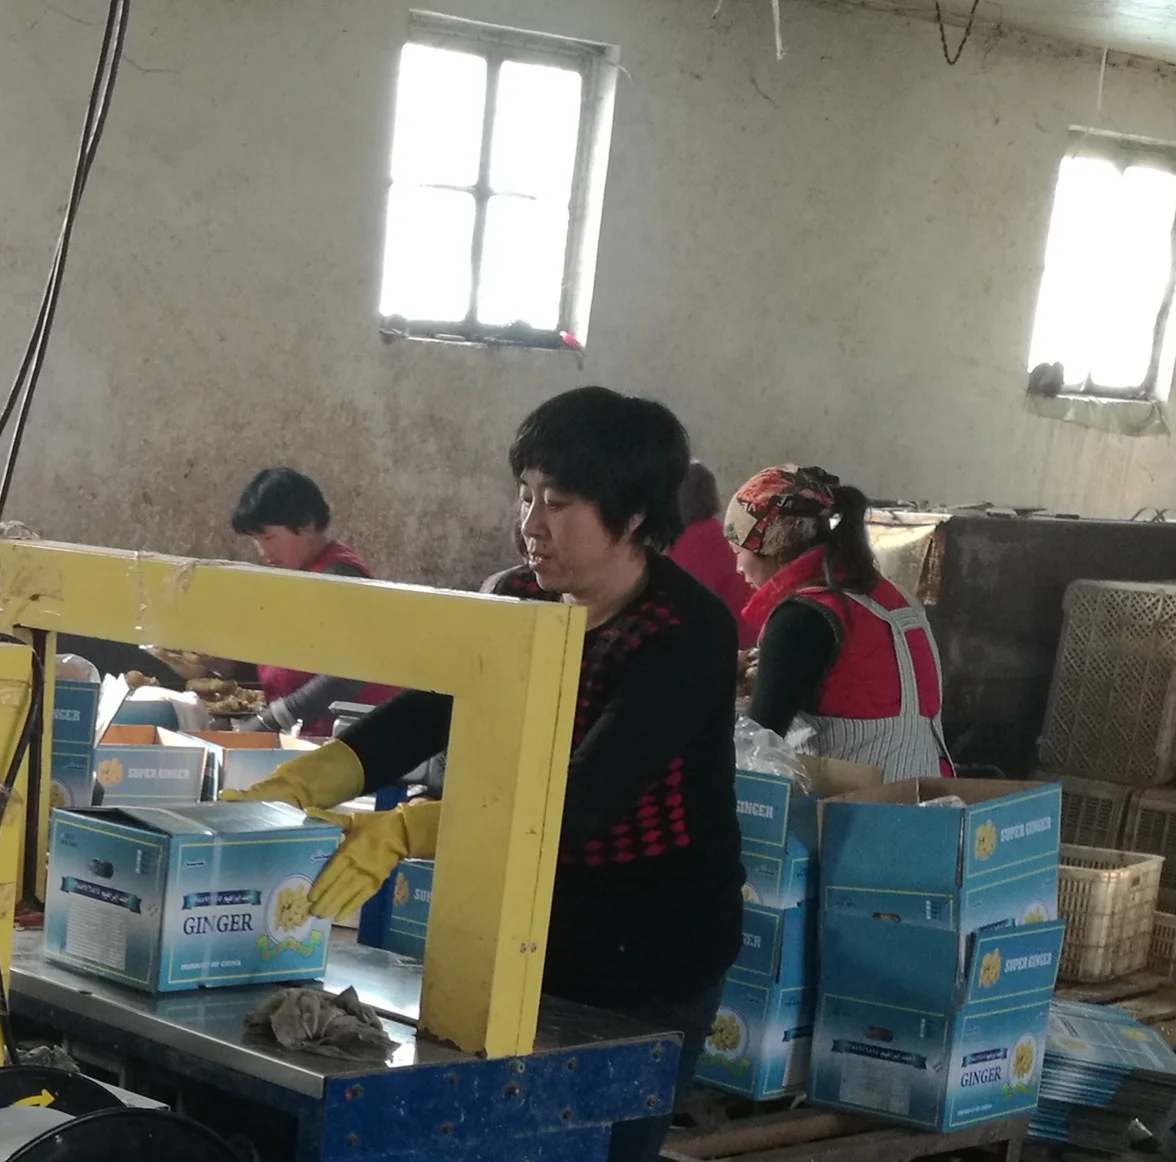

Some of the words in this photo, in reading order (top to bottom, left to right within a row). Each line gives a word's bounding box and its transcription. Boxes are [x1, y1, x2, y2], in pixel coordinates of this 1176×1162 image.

[1000, 824, 1025, 842] SUPER
[1025, 817, 1051, 836] GINGER
[183, 913, 253, 935] GINGER
[1005, 956, 1028, 973] SUPER
[1028, 952, 1052, 969] GINGER
[961, 1066, 1001, 1088] GINGER
